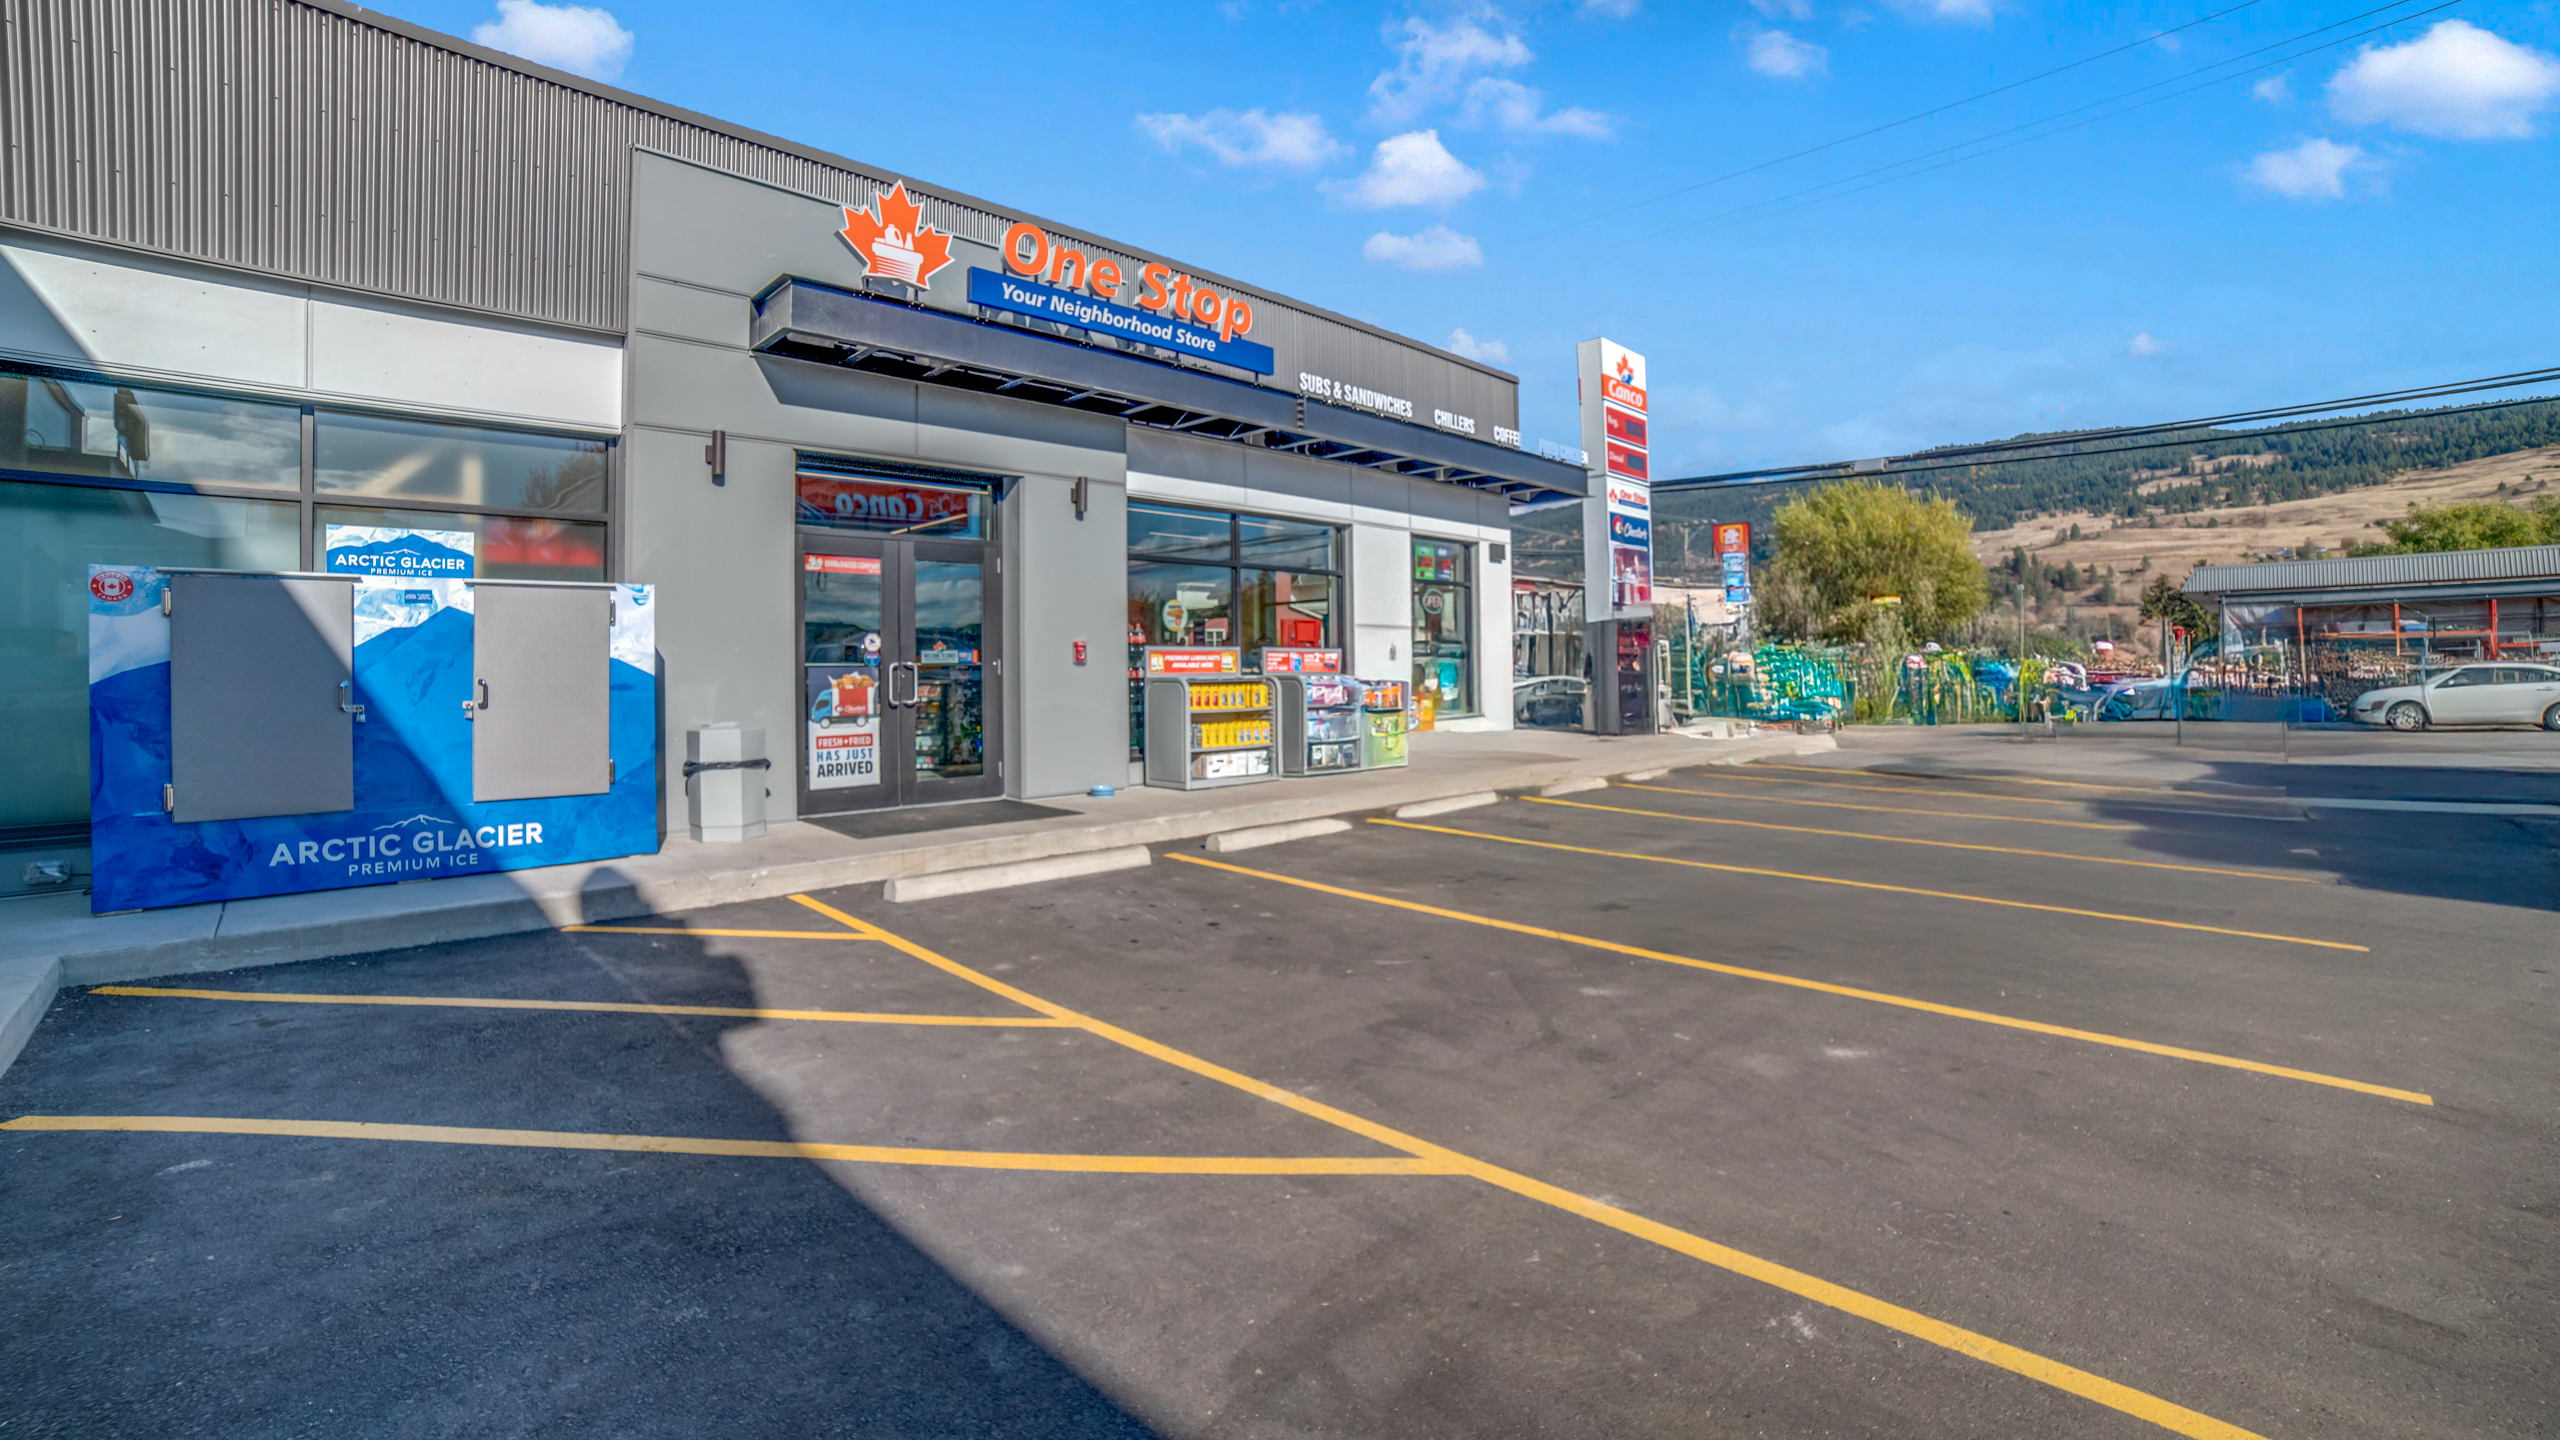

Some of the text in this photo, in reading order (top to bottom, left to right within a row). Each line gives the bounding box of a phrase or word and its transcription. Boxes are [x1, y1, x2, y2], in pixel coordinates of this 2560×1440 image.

[1001, 222, 1253, 344] One Stop
[1001, 281, 1217, 352] Your Neighborhood Store
[1299, 371, 1414, 419] SUBS & SANDWICHES
[1608, 378, 1644, 407] Canco
[1434, 408, 1475, 435] CHILLERS
[334, 553, 466, 571] ARCTIC GLACIER
[370, 567, 433, 577] PREMIUM ICE
[96, 592, 129, 602] CANADA
[816, 748, 873, 762] HAS JUST
[817, 760, 874, 778] ARRIVED
[268, 822, 544, 868] ARCTIC GLACIER
[348, 852, 479, 877] PREMIUM ICE
